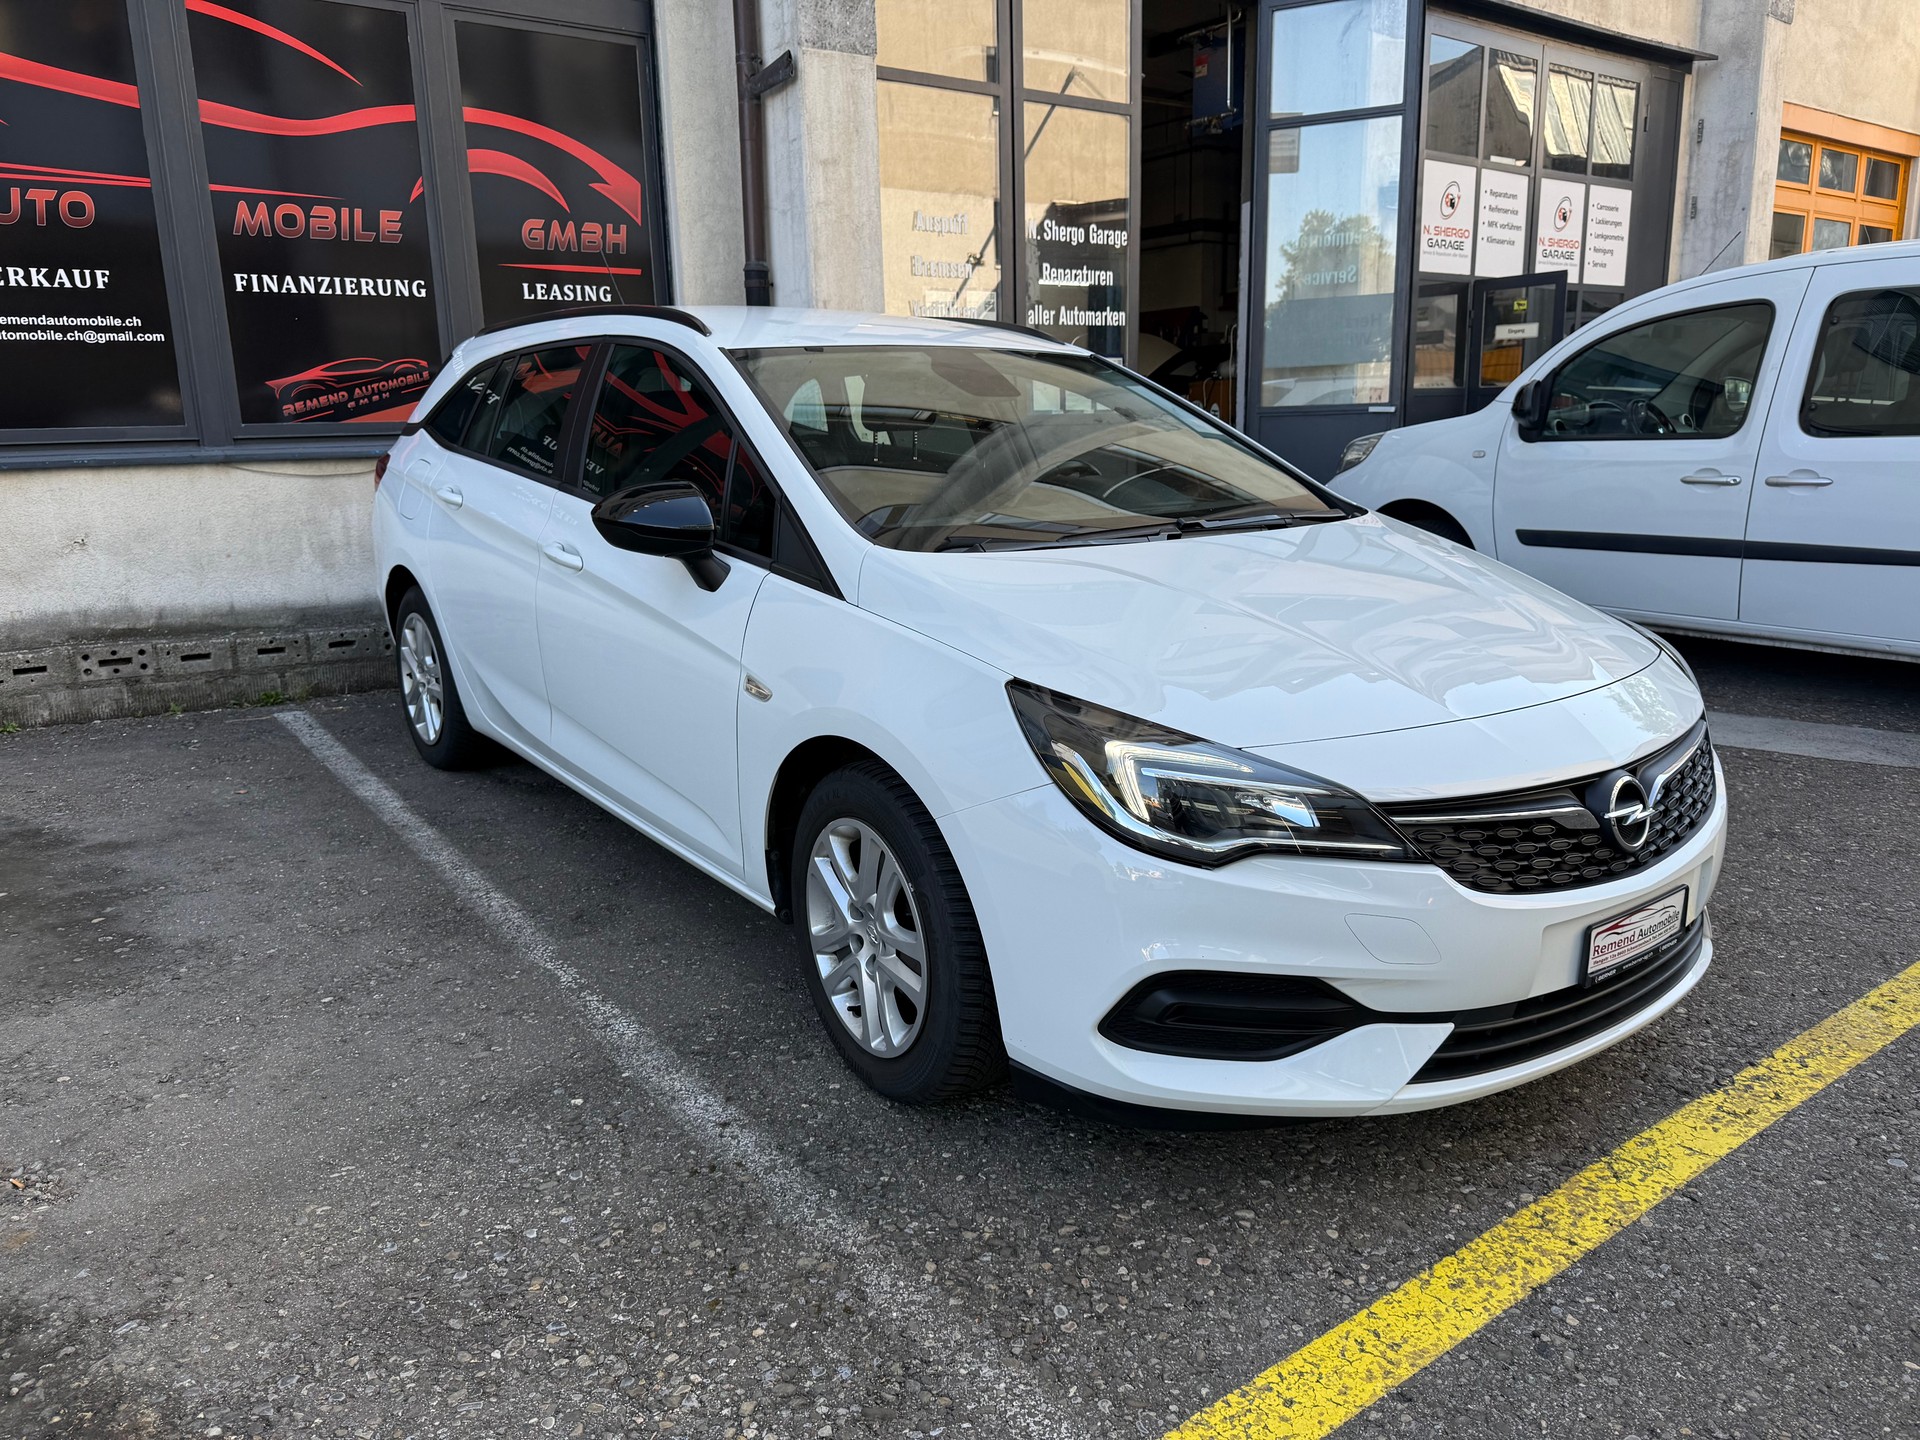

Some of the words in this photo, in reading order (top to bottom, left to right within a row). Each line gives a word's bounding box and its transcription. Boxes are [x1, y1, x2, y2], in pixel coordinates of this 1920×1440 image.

[1489, 188, 1518, 201] Reparaturen
[1488, 204, 1519, 216] Reifenservice
[1596, 203, 1619, 213] Carrosserie
[232, 200, 403, 244] MOBILE
[521, 218, 627, 255] GMBH
[915, 209, 969, 236] Auspuff
[1595, 217, 1623, 228] Lackierungen
[1028, 219, 1041, 240] N.
[1043, 219, 1085, 246] Shergo
[1089, 224, 1128, 249] Garage
[1423, 225, 1432, 235] N.
[1433, 226, 1470, 239] SHERGO
[1594, 232, 1625, 242] Lenkgeometrie
[1427, 238, 1464, 251] GARAGE
[1486, 236, 1516, 247] Klimaservice
[1539, 237, 1547, 247] N.
[1548, 238, 1580, 250] SHERGO
[1542, 248, 1575, 261] GARAGE
[1593, 245, 1614, 257] Reinigung
[913, 255, 973, 279] Bremsen
[1592, 260, 1607, 269] Service
[1042, 262, 1114, 287] Reparaturen
[0, 266, 110, 289] RKAUF
[233, 273, 428, 298] FINANZIERUNG
[522, 282, 612, 303] LEASING
[1028, 305, 1054, 326] aller
[1059, 306, 1126, 327] Automarken
[282, 391, 349, 417] REMEND
[354, 371, 431, 399] AUTOMOBILE
[1592, 931, 1635, 957] Remend
[1637, 909, 1680, 939] Automobile
